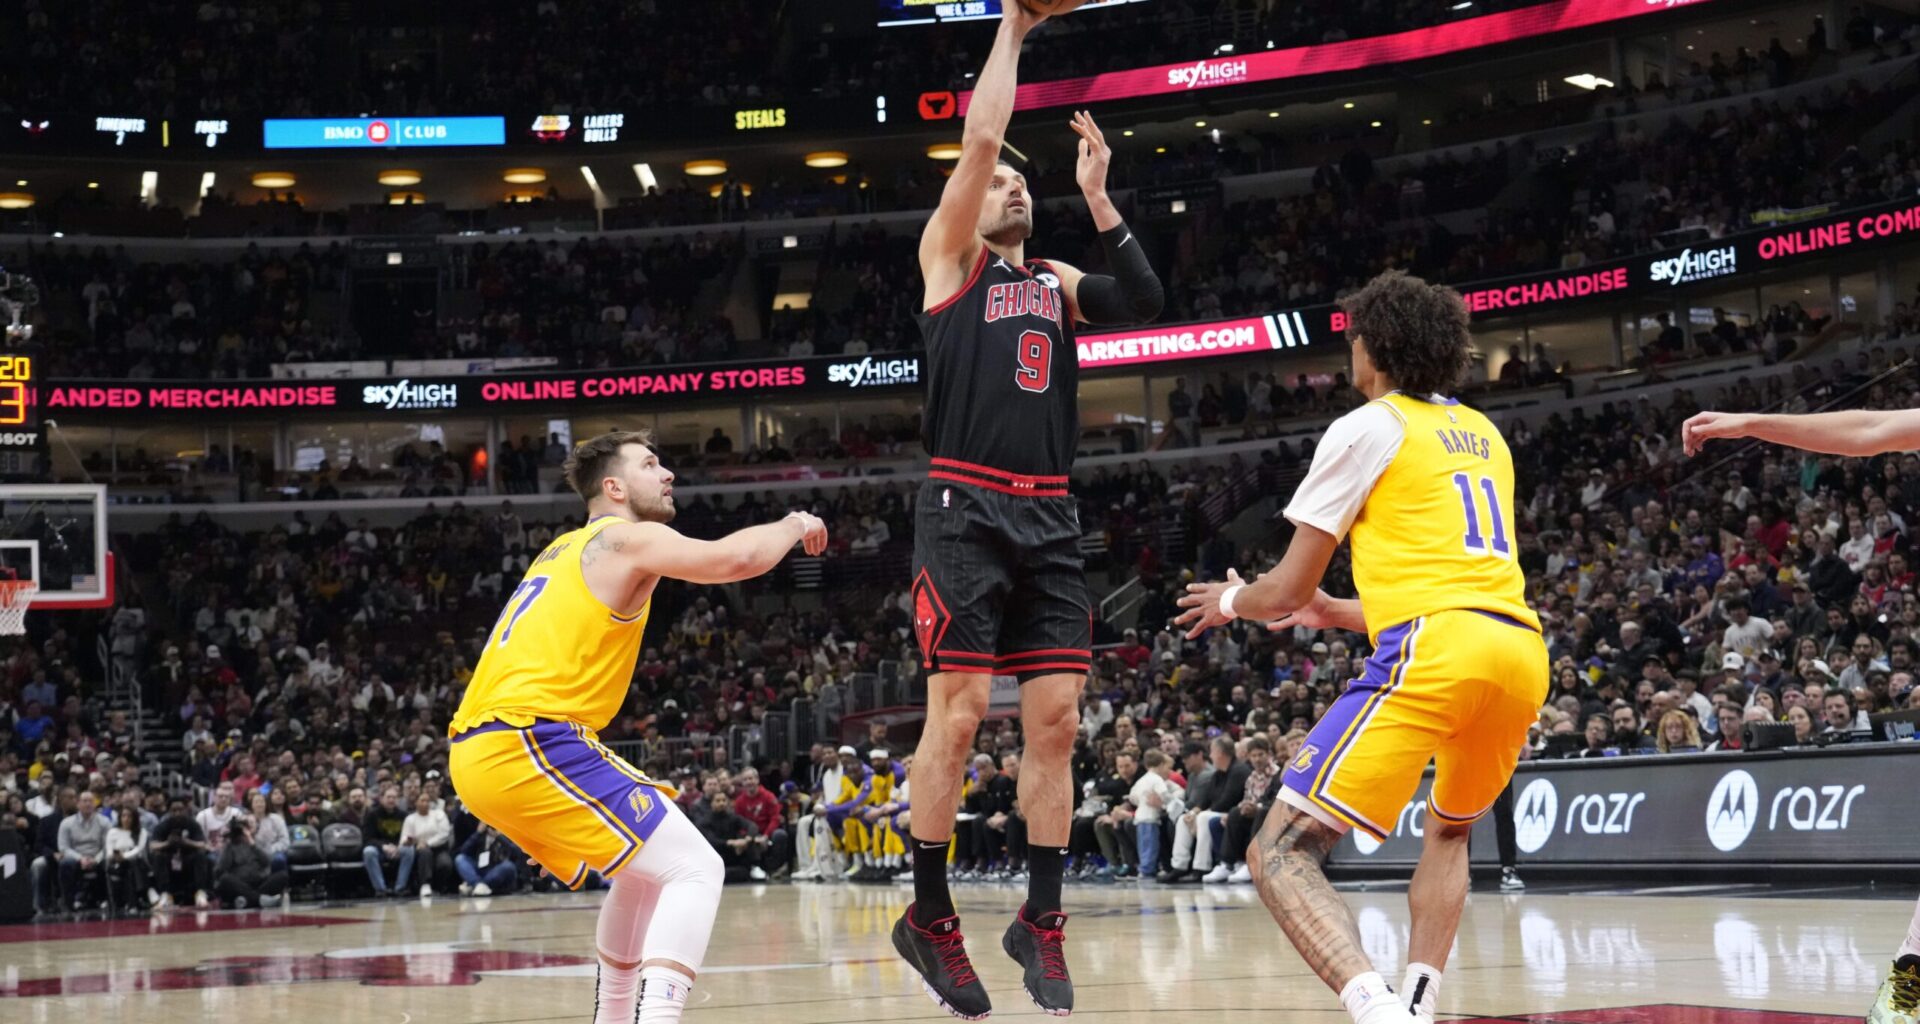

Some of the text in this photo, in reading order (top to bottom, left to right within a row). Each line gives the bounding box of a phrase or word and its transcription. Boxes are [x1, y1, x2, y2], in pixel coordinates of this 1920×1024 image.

[96, 117, 146, 132] TIMEOUTS
[195, 120, 228, 134] FOULS
[583, 114, 624, 128] LAKERS
[735, 108, 786, 130] STEALS
[324, 125, 447, 140] BMO CLUB
[584, 128, 618, 142] BULLS
[1758, 222, 1851, 259] ONLINE
[0, 357, 30, 380] 20
[1015, 329, 1052, 393] 9
[149, 386, 336, 407] MERCHANDISE
[481, 380, 576, 401] ONLINE
[582, 372, 704, 397] COMPANY
[710, 366, 805, 390] STORES
[1437, 429, 1490, 460] HAYES
[1453, 473, 1510, 557] 11
[1565, 792, 1646, 834] razr
[1768, 784, 1866, 831] razr
